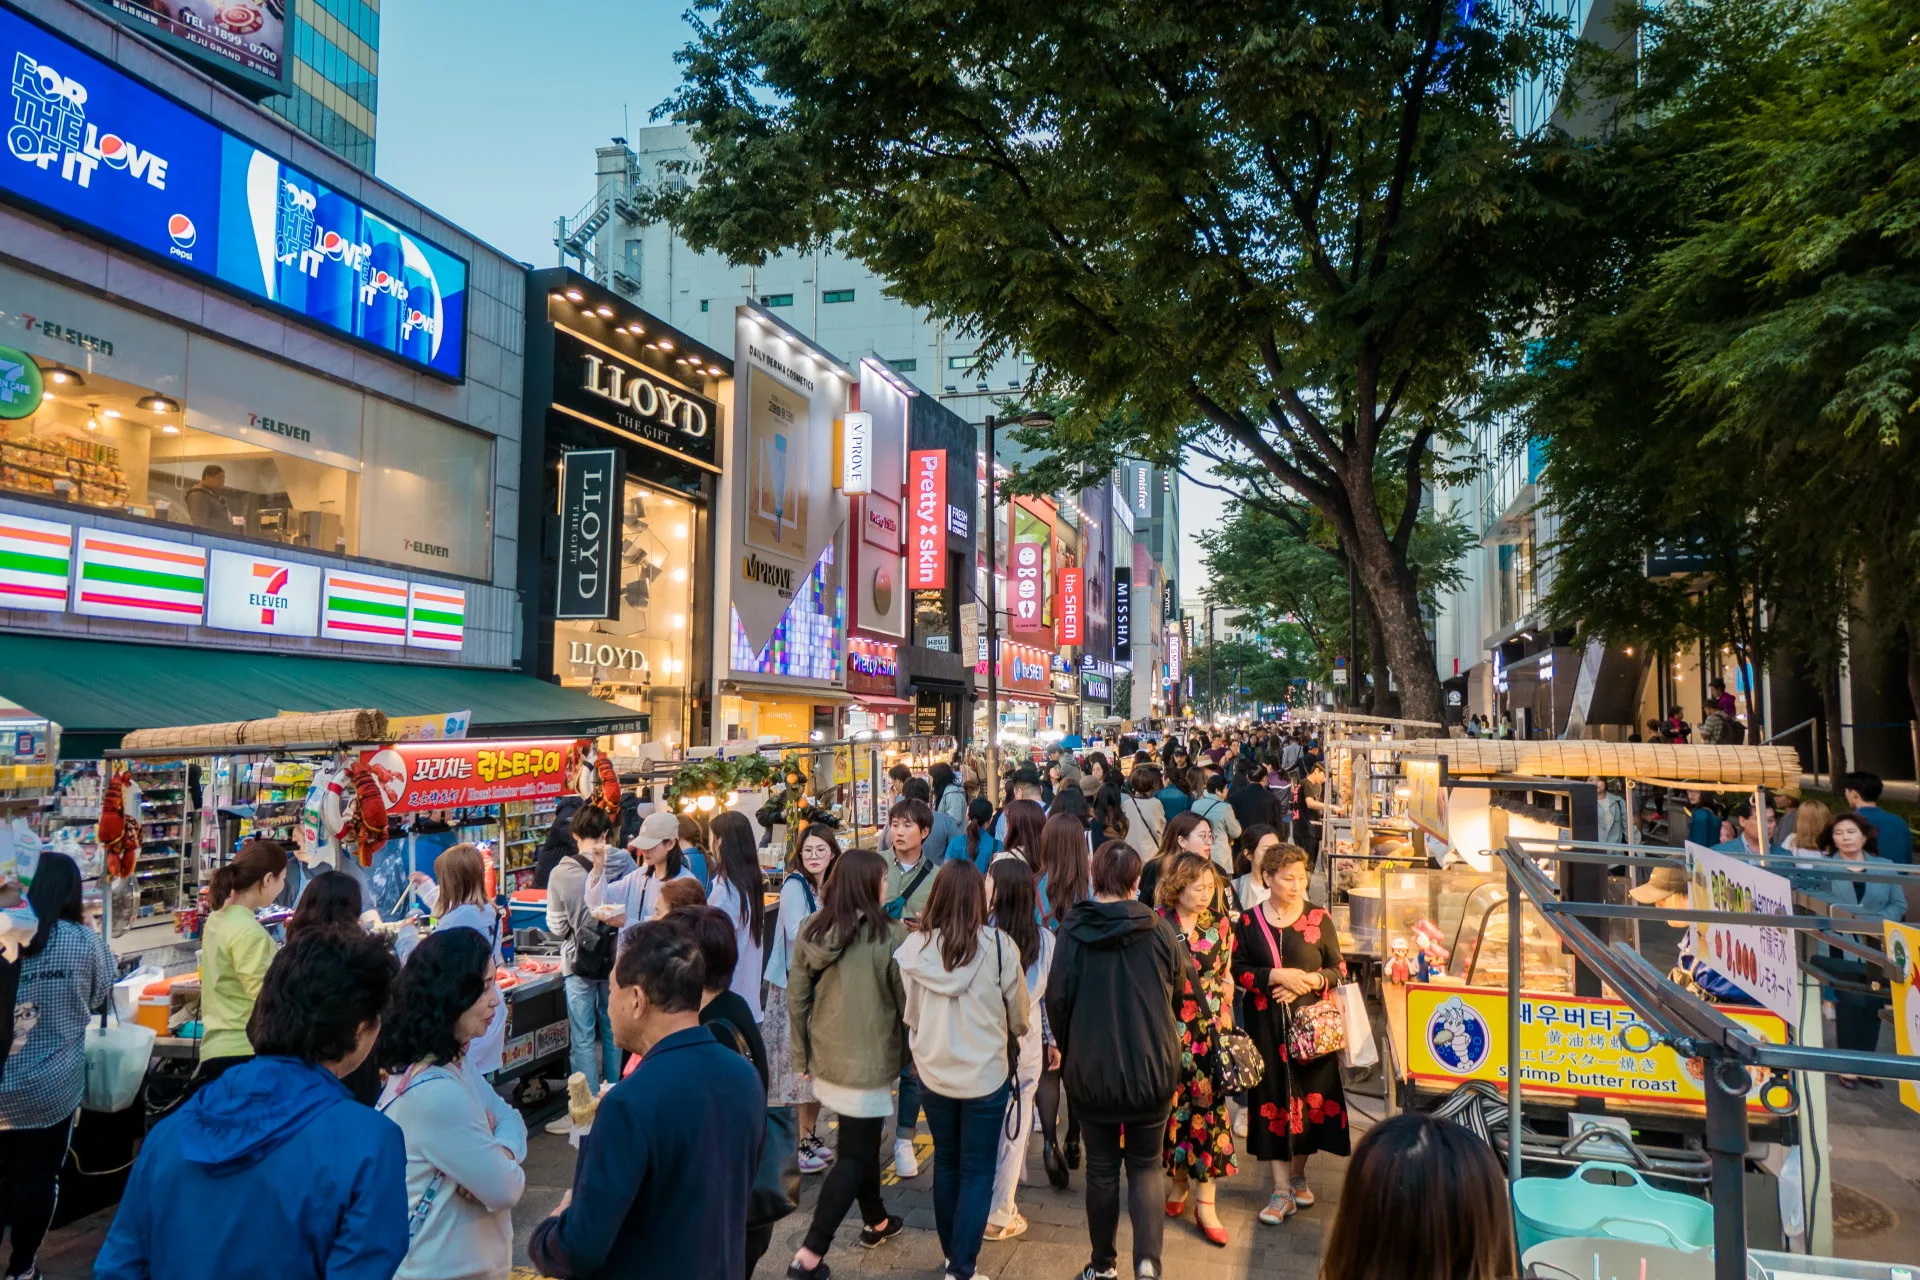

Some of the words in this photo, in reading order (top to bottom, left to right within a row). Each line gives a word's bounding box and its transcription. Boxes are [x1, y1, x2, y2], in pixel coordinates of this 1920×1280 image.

[185, 32, 208, 47] JEJU
[209, 42, 241, 62] GRAND
[12, 51, 88, 119] FOR
[11, 85, 83, 150] THE
[83, 122, 169, 191] LOVE
[7, 124, 61, 170] OF
[61, 147, 99, 188] IT
[277, 177, 317, 222] FOR
[169, 246, 193, 261] pepsi
[276, 205, 315, 248] THE
[313, 225, 362, 272] LOVE
[299, 248, 324, 279] IT
[749, 343, 767, 361] DAILY
[766, 355, 786, 375] DERMA
[786, 367, 814, 392] COSMETICS
[10, 381, 31, 395] CAFE
[580, 353, 707, 438] LLOYD
[616, 411, 641, 431] THE
[643, 424, 671, 444] GIFT
[916, 455, 938, 522] Pretty
[1138, 467, 1148, 510] innisfree
[571, 504, 580, 531] THE
[952, 506, 968, 523] FRESH
[570, 534, 578, 565] GIFT
[578, 469, 602, 599] LLOYD
[919, 539, 938, 582] skin
[252, 562, 289, 625] 7
[1064, 574, 1076, 593] the
[1117, 582, 1128, 646] MISSHA
[569, 641, 645, 671] LLOYD
[853, 651, 877, 678] Pretty
[881, 658, 897, 677] skin
[1171, 637, 1179, 679] LESMORE
[1088, 680, 1108, 699] MISSHA
[412, 756, 473, 782] 꼬리치는
[477, 748, 560, 783] 랍스터구이
[536, 781, 561, 793] Cheese
[1758, 963, 1792, 1006] レモネード
[1499, 1065, 1561, 1084] srimp
[1567, 1070, 1625, 1088] butter
[1631, 1077, 1678, 1092] roast
[1519, 1049, 1657, 1074] エビバター焼き
